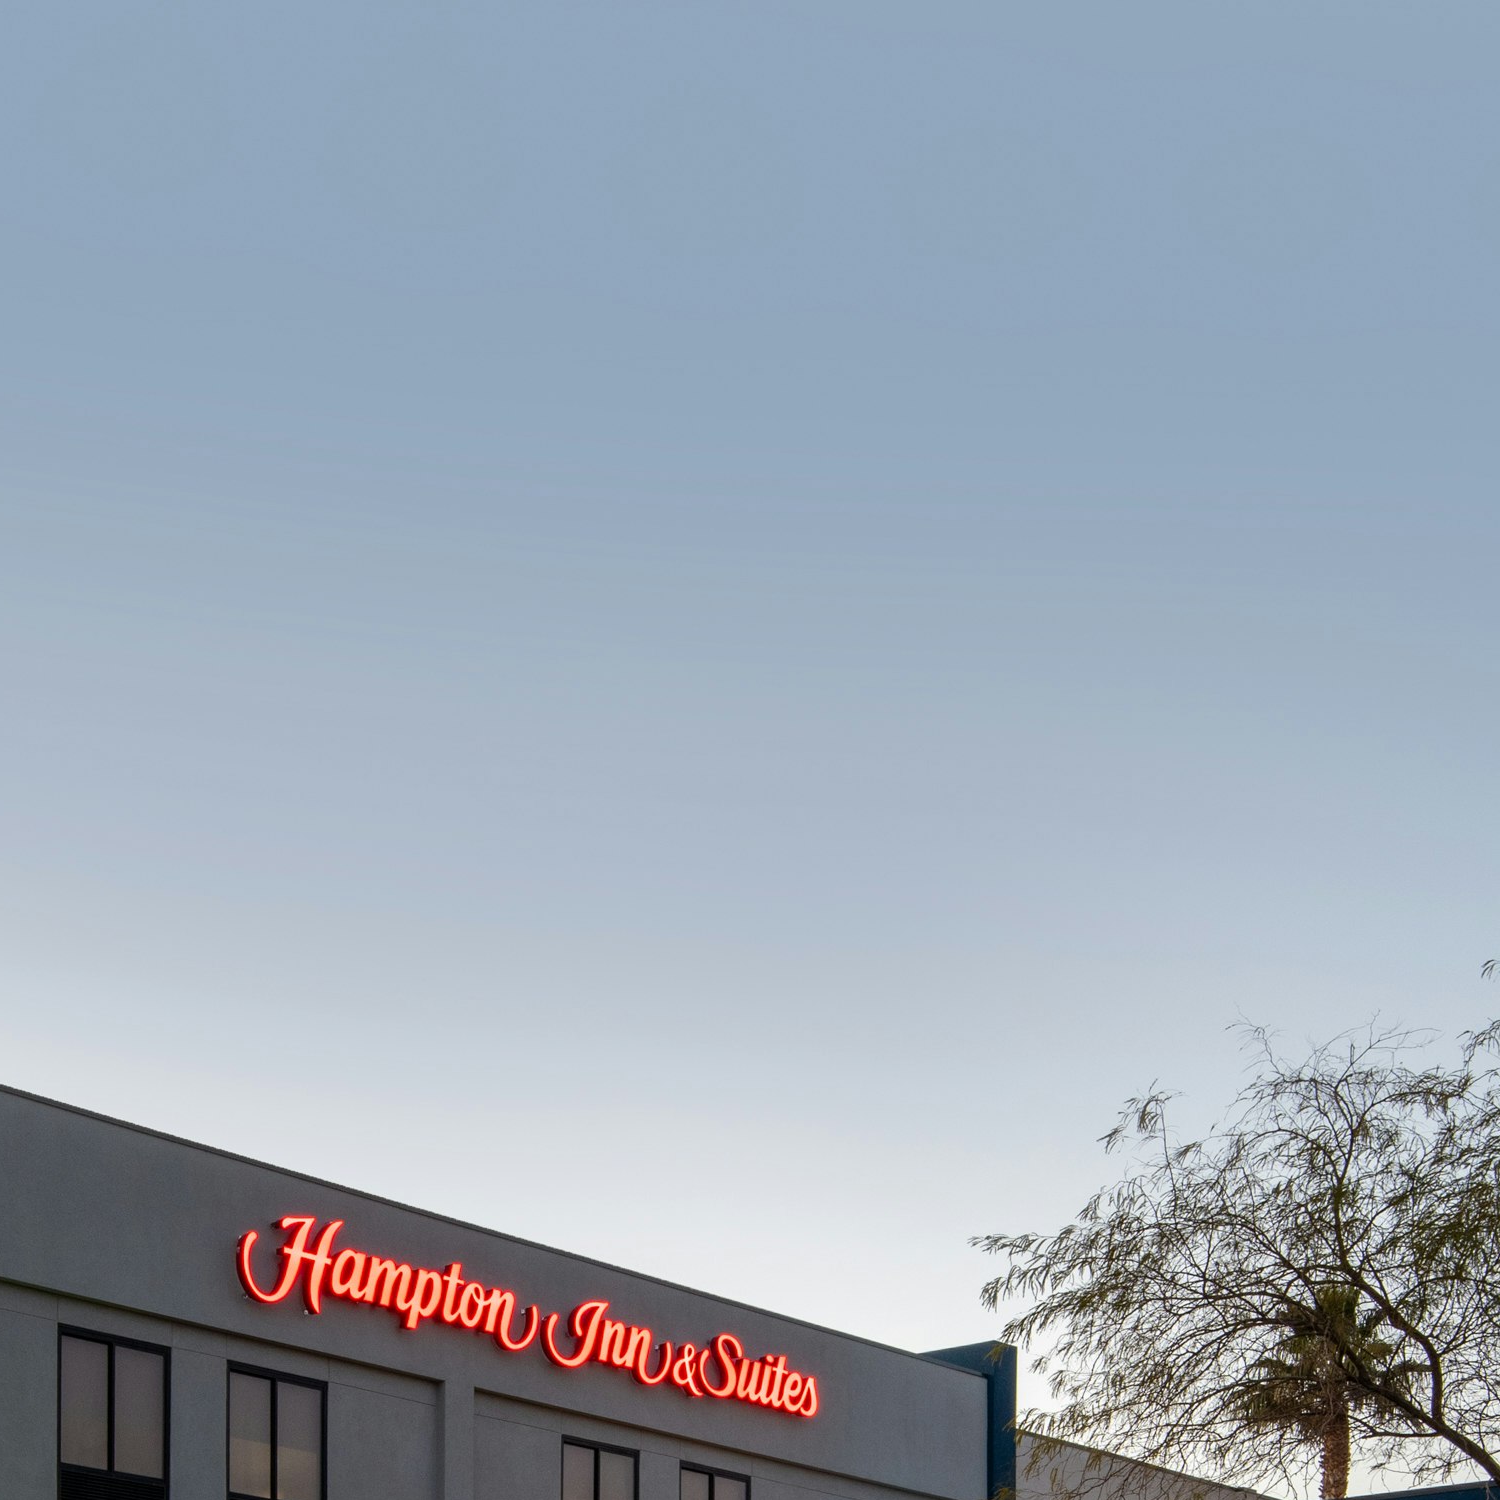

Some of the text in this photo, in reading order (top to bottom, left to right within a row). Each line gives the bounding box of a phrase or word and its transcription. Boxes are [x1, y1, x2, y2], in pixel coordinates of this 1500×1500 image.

[237, 1215, 819, 1418] Hampton Inn & Suites
